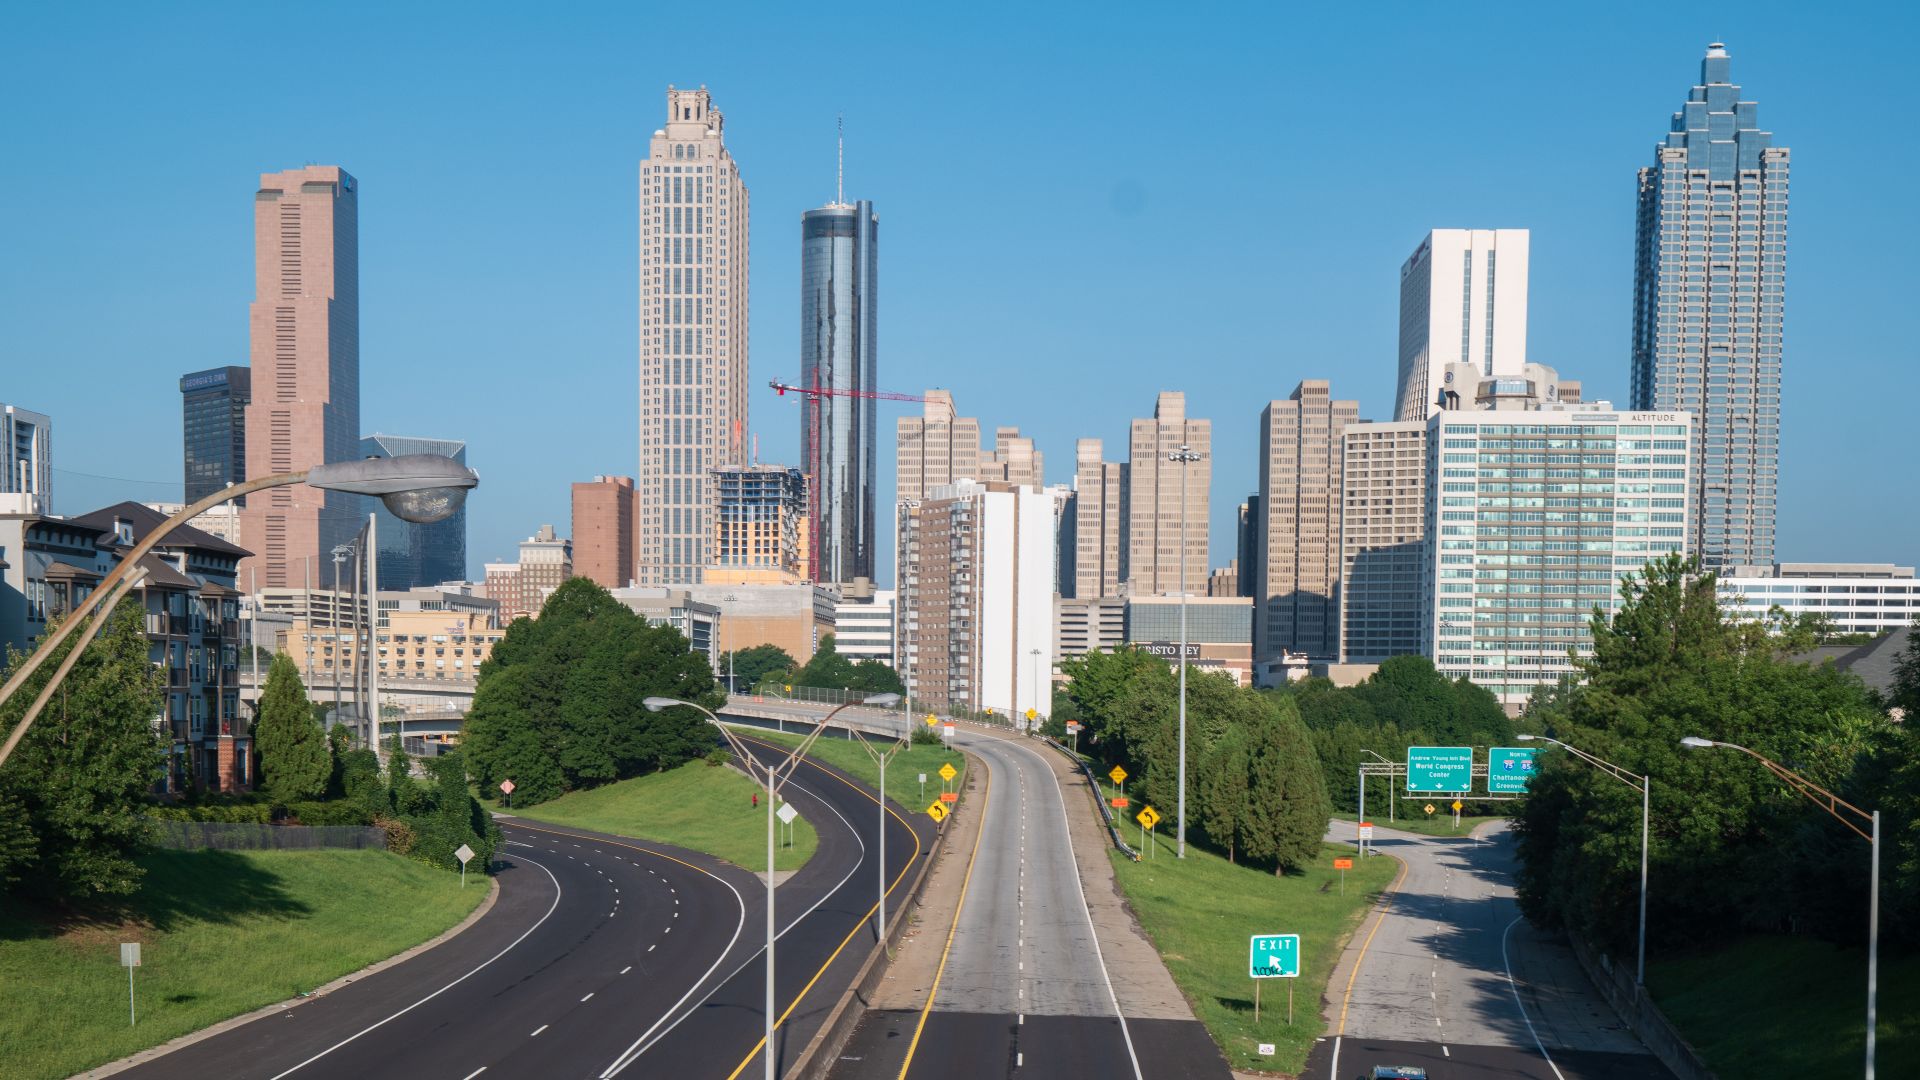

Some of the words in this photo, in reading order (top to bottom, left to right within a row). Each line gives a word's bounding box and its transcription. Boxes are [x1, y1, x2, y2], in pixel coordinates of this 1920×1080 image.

[1632, 414, 1675, 422] ALTITUDE
[1180, 646, 1199, 655] EY
[1435, 763, 1465, 771] Congress
[1259, 939, 1291, 950] EXIT
